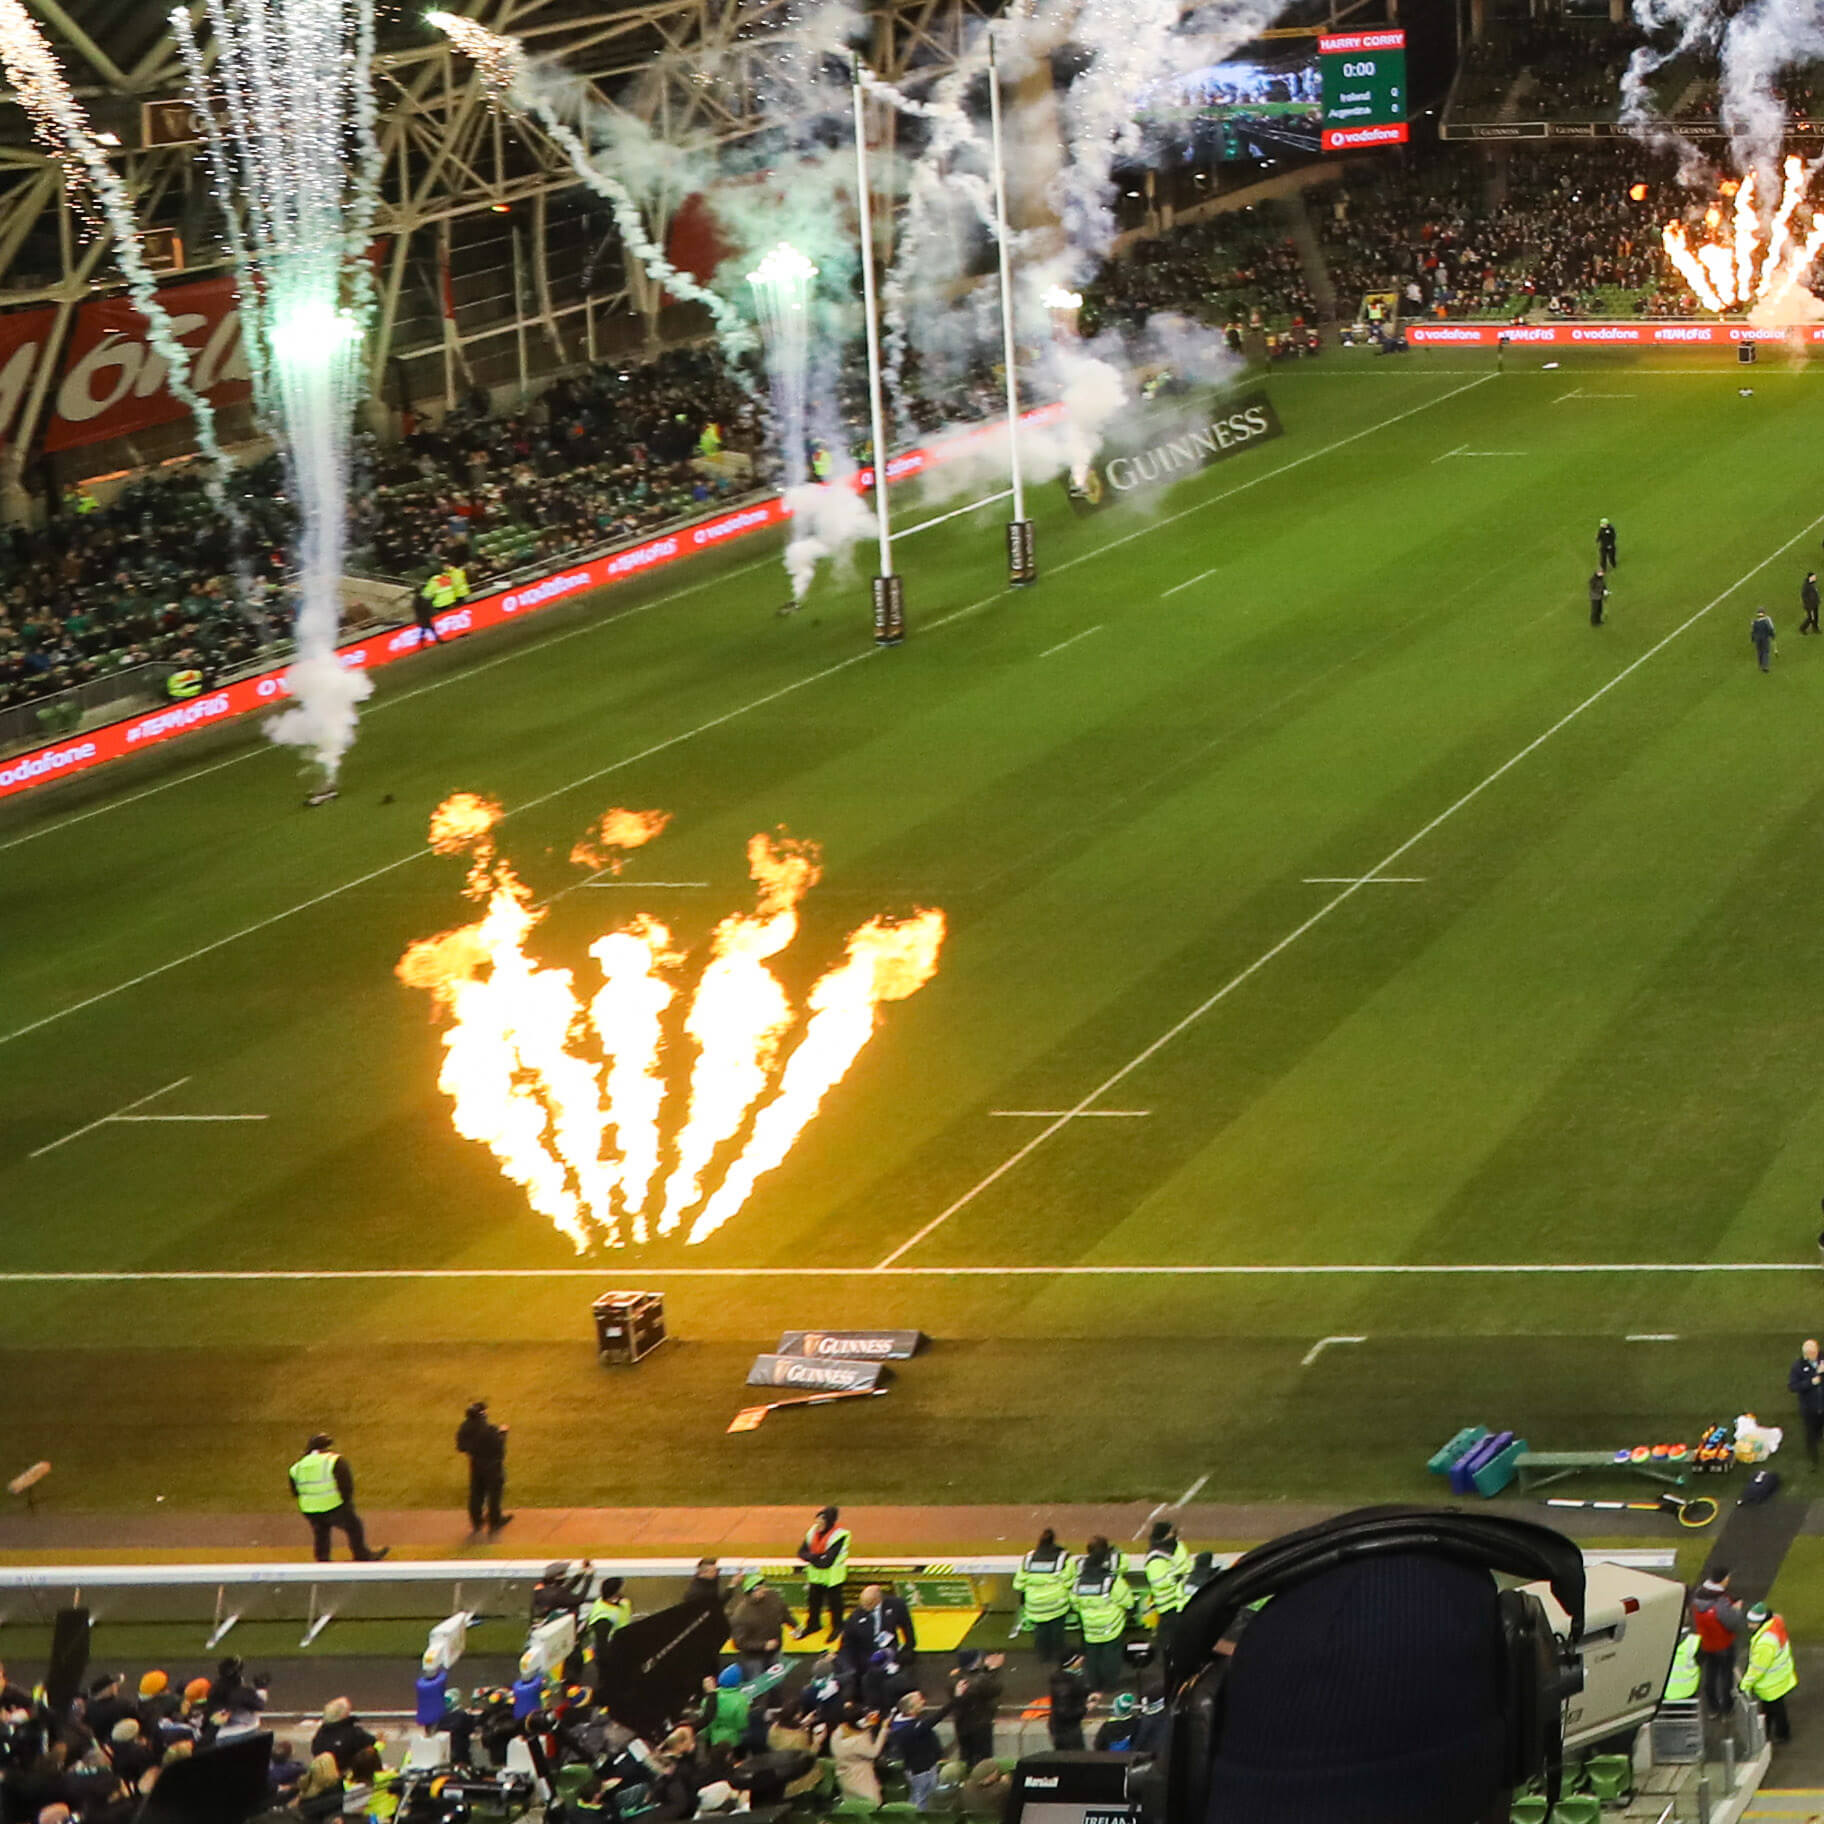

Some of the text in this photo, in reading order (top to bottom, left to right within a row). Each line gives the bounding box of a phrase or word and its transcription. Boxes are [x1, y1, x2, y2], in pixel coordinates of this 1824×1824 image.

[1320, 34, 1404, 49] HARRY CORRY
[1343, 62, 1375, 77] 0:00
[1345, 129, 1399, 143] vodafone
[1426, 329, 1480, 340] vodafone
[1583, 329, 1638, 340] vodafone
[1105, 406, 1269, 491] GUINNESS
[817, 1336, 896, 1354] GUINNESS
[786, 1363, 860, 1384] GUINNESS
